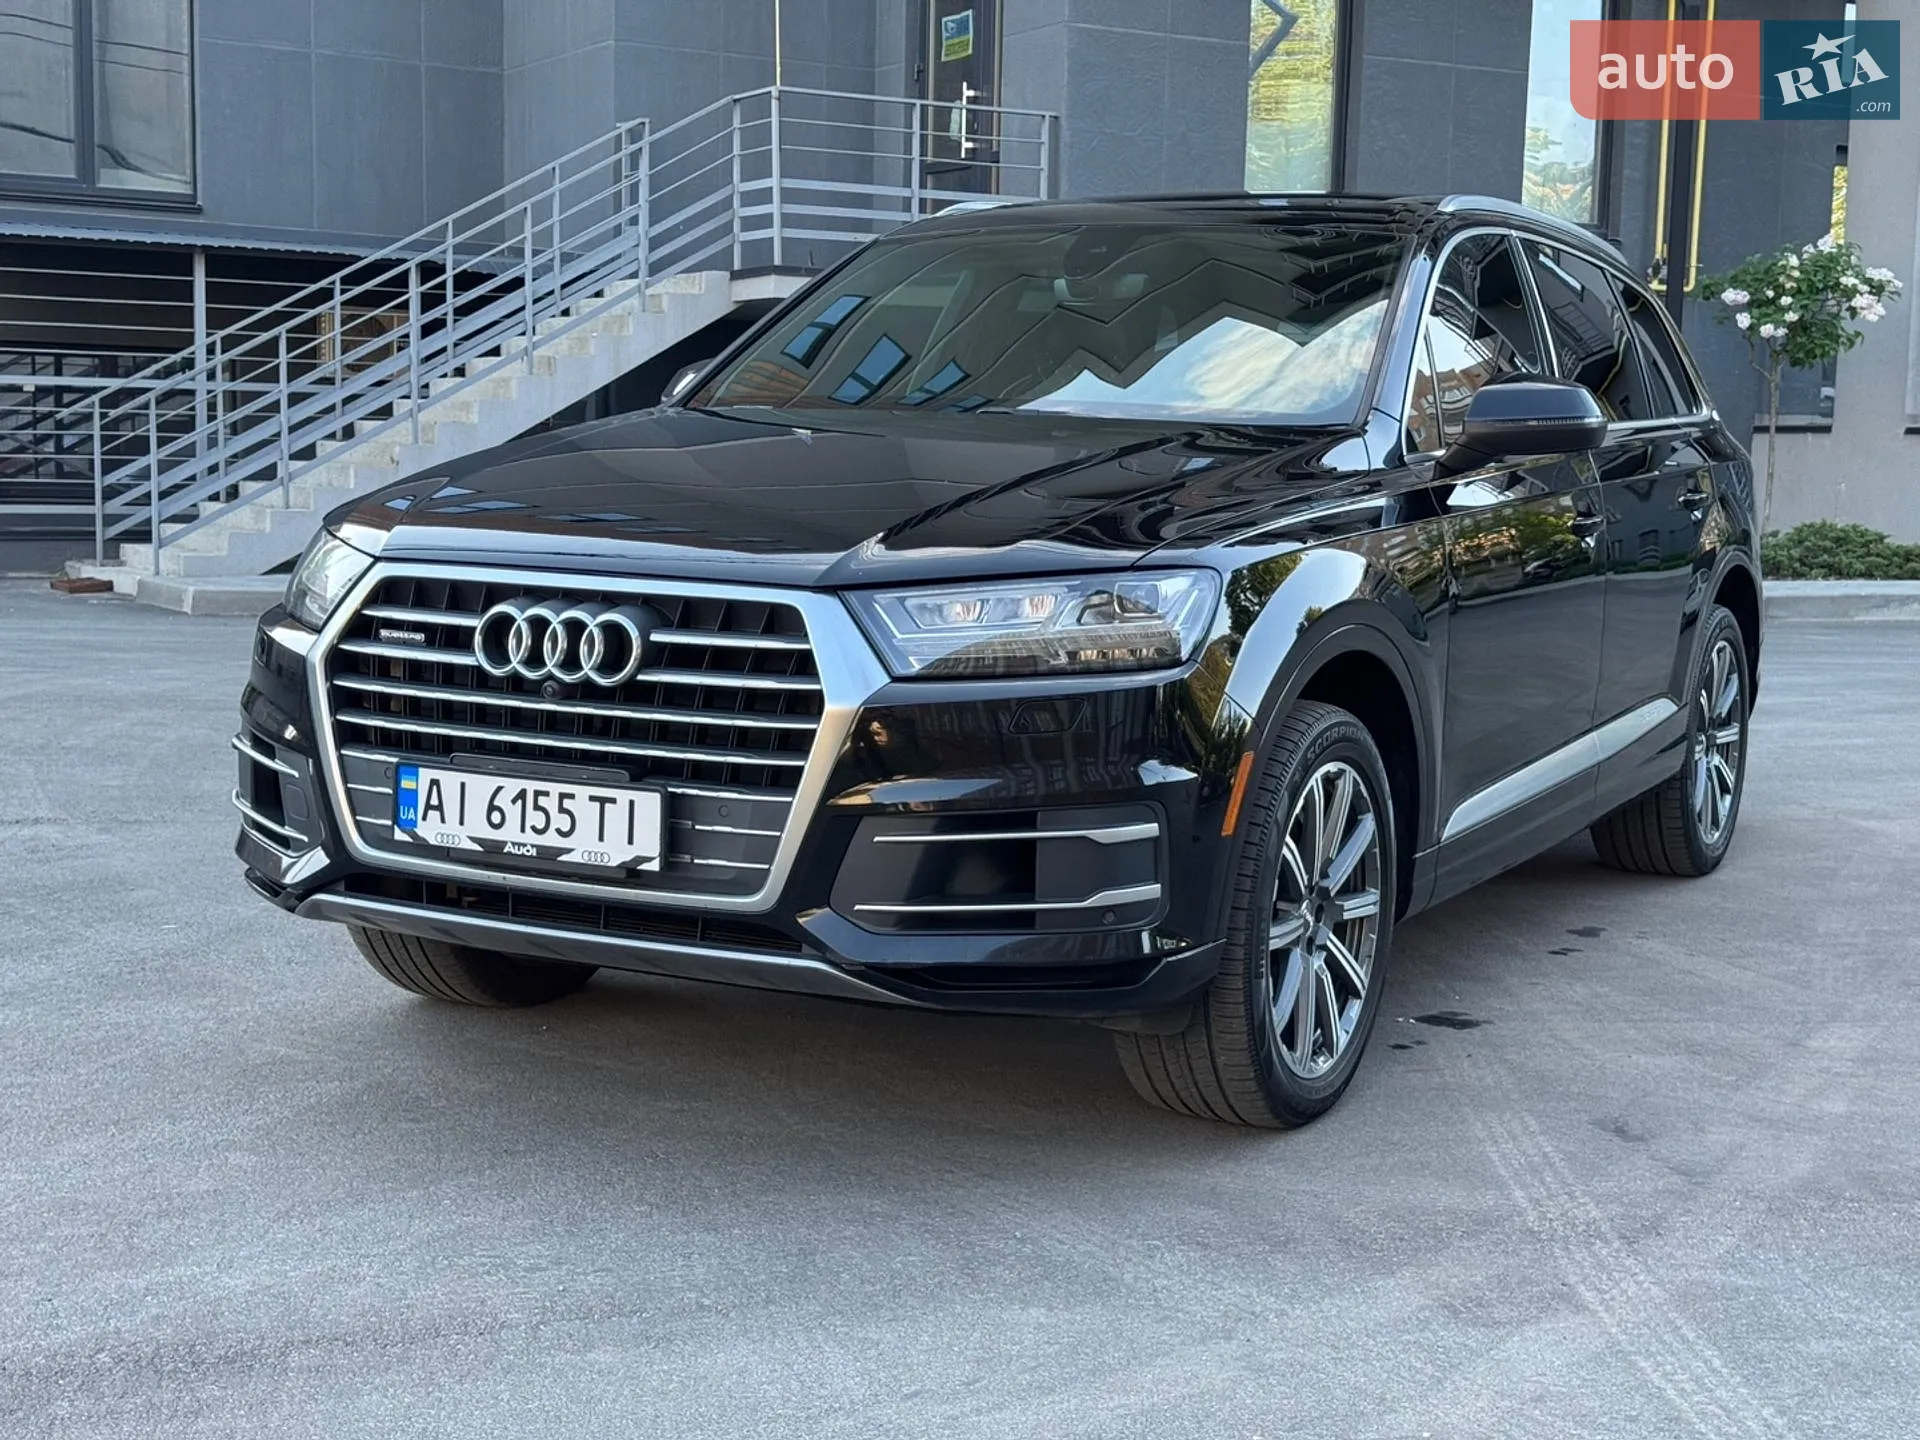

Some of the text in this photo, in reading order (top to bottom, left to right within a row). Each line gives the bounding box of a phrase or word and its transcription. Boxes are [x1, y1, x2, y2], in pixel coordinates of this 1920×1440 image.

[399, 804, 416, 821] UA
[421, 778, 635, 846] AI 6155 TI
[503, 841, 536, 856] Audi
